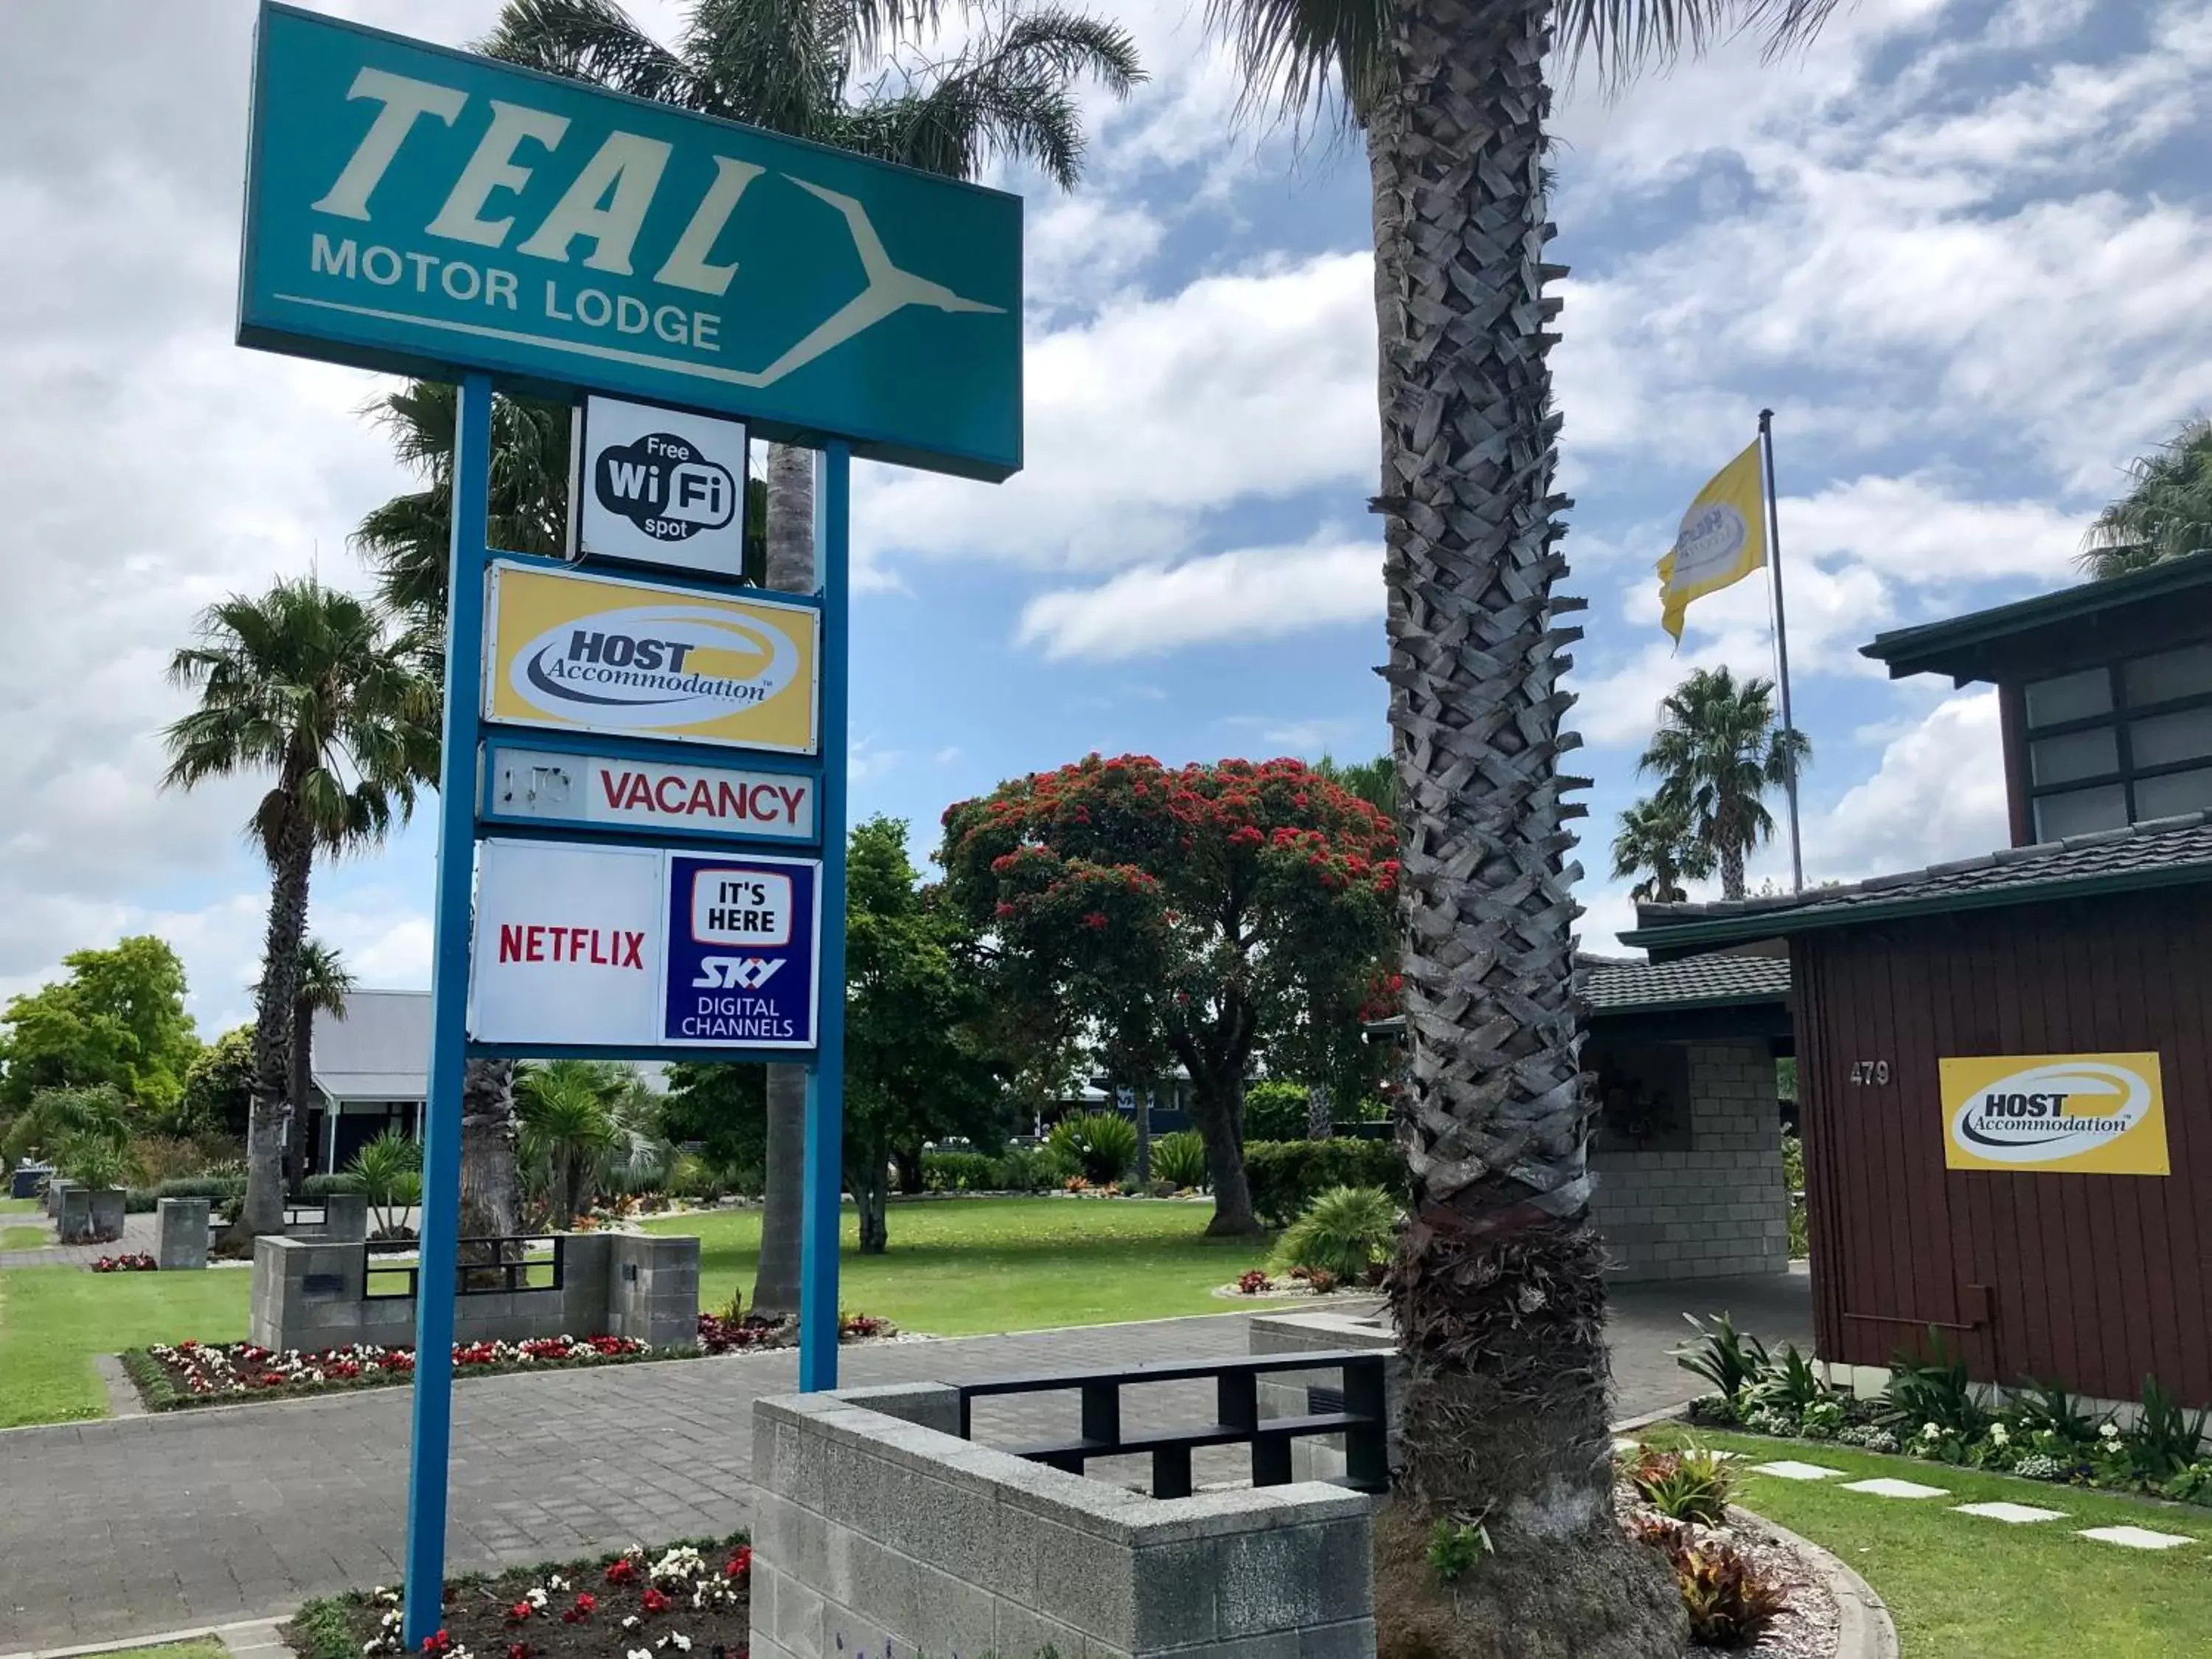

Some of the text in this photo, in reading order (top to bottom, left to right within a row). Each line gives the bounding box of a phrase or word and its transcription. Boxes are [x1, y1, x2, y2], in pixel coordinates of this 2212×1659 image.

[311, 66, 767, 296] TEAL
[310, 234, 722, 352] MOTOR LODGE
[647, 437, 689, 461] Free
[645, 519, 689, 539] spot
[568, 630, 694, 673] HOST
[547, 658, 765, 702] Accommodation
[600, 770, 805, 825] VACANCY
[719, 881, 765, 906] IT'S
[709, 908, 775, 933] HERE
[499, 924, 645, 970] NETFLIX
[692, 956, 787, 989] SKY
[698, 997, 779, 1017] DIGITAL
[682, 1018, 793, 1037] CHANNELS
[1849, 1060, 1889, 1086] 479
[1985, 1093, 2069, 1117] HOST
[1972, 1114, 2127, 1133] Accommodation
